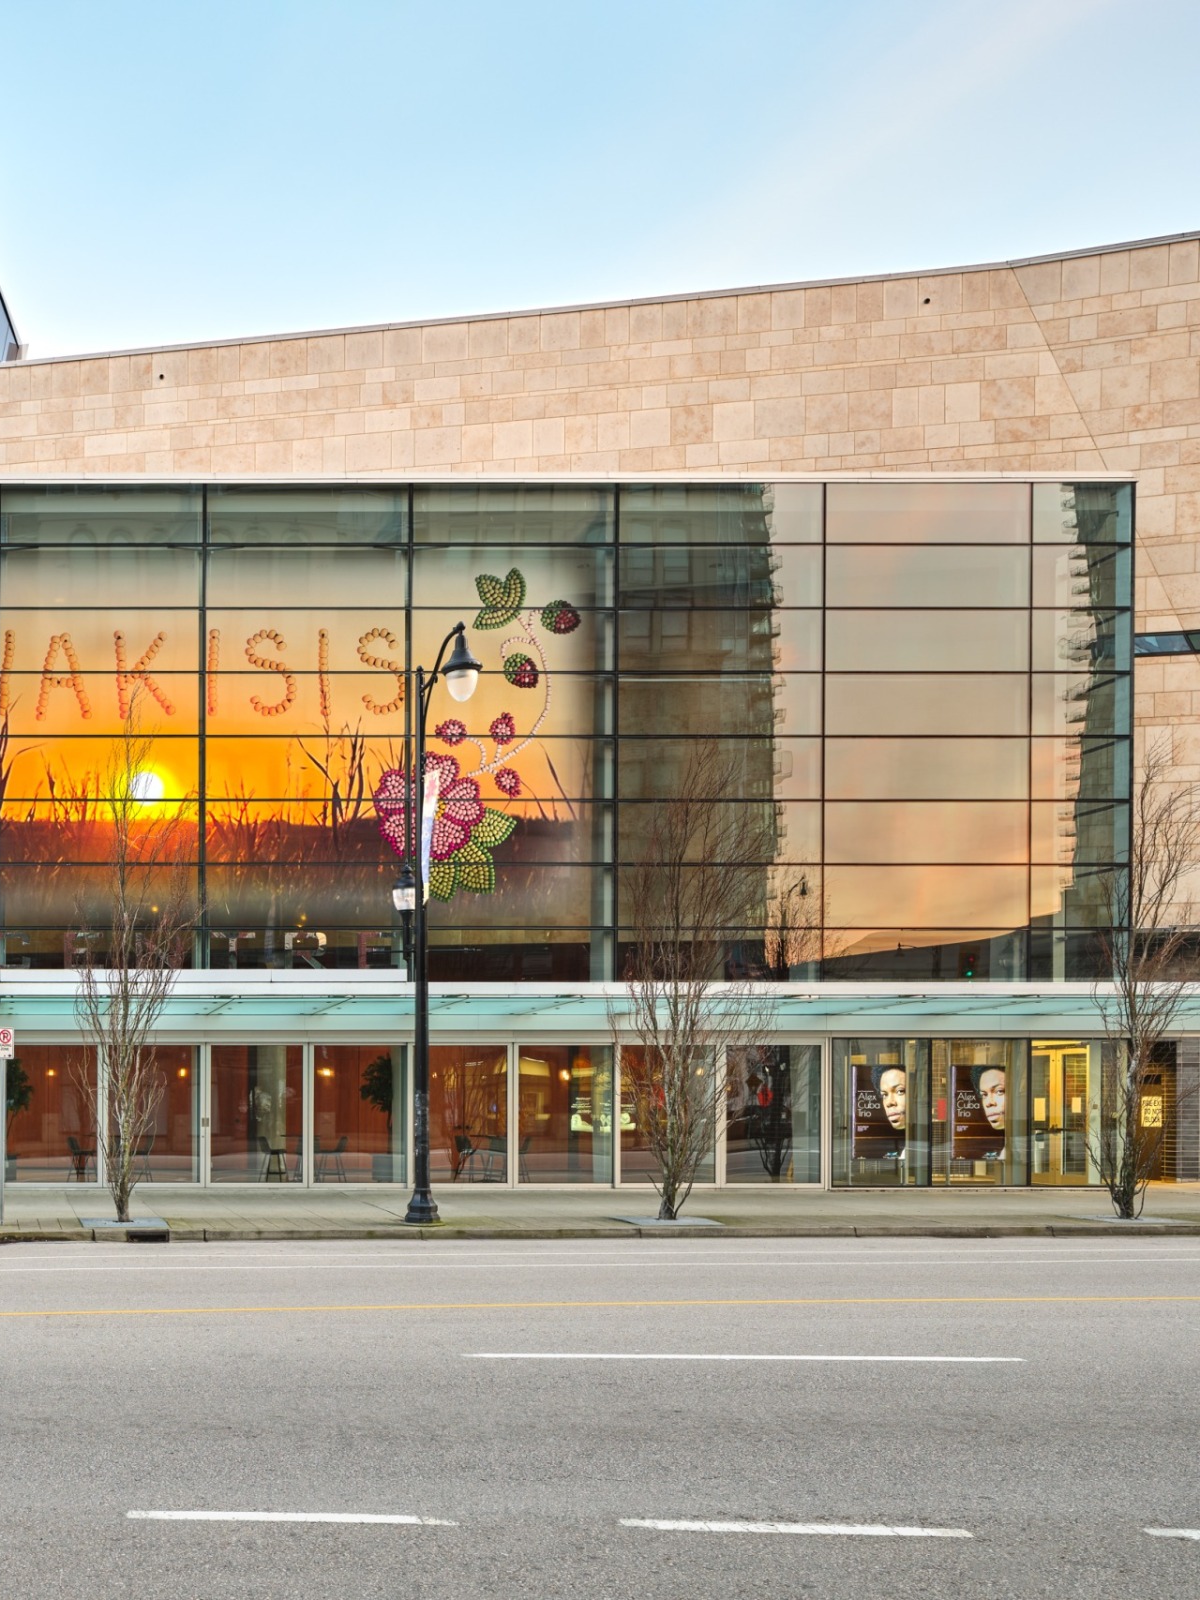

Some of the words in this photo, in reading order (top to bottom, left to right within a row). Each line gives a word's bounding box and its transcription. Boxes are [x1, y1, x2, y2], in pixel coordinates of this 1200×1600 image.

[857, 1092, 877, 1101] Alex
[957, 1092, 976, 1101] Alex
[857, 1100, 881, 1109] Cuba
[956, 1100, 980, 1109] Cuba
[857, 1109, 872, 1118] Trio
[956, 1109, 971, 1118] Trio
